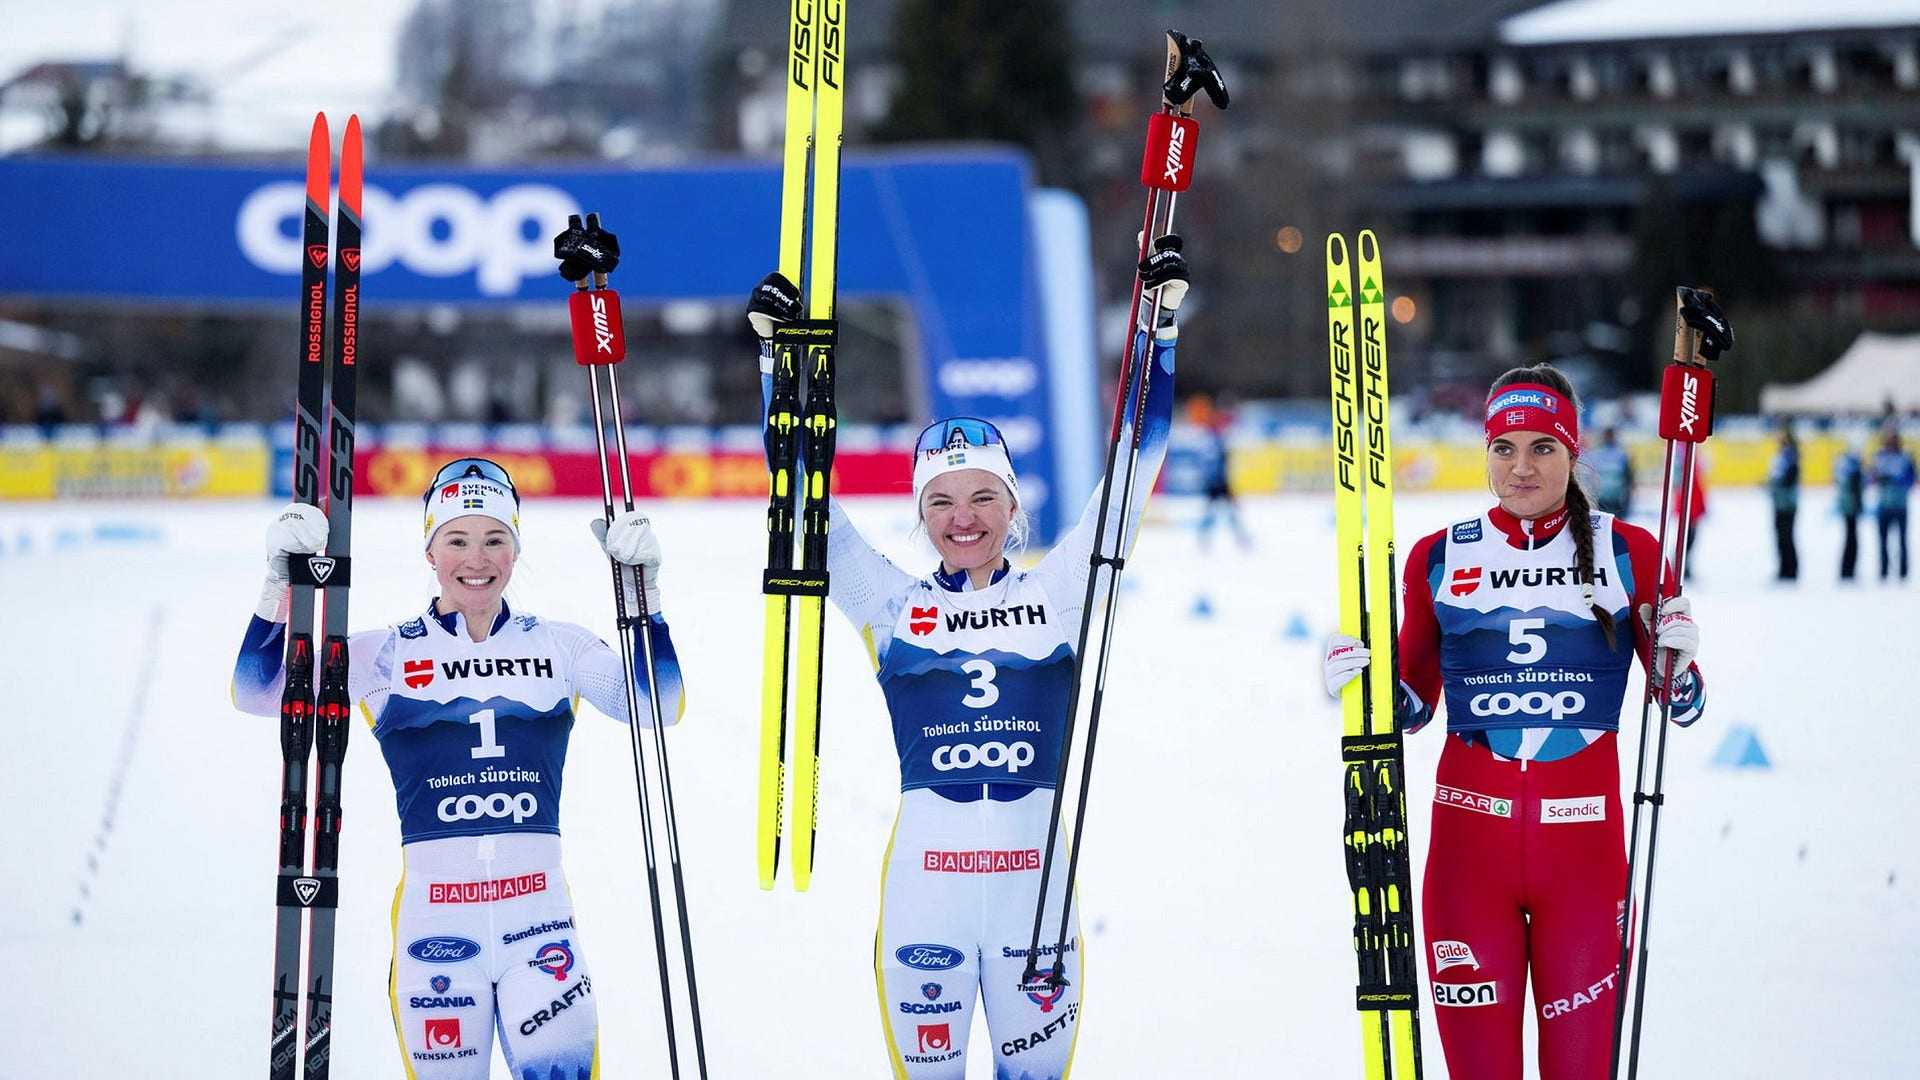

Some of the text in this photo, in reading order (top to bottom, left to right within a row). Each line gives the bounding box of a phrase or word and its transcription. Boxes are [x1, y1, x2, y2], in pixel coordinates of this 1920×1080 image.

[793, 0, 811, 90] FISC
[823, 0, 840, 90] FISC
[308, 281, 324, 362] ROSSIGNOL
[343, 284, 357, 365] ROSSIGNOL
[776, 328, 833, 336] FISCHER
[1333, 320, 1355, 492] FISCHER
[1364, 317, 1386, 488] FISCHER
[946, 444, 968, 452] SPEL
[462, 484, 504, 497] SVENSKA
[768, 579, 825, 587] FISCHER
[1505, 618, 1548, 664] 5
[959, 658, 1000, 709] 3
[1470, 690, 1586, 720] coop
[469, 708, 506, 760] 1
[922, 722, 970, 738] Toblach
[931, 741, 1035, 773] coop
[1344, 743, 1397, 752] FISCHER
[426, 772, 475, 790] Toblach
[437, 792, 538, 824] coop
[1439, 789, 1490, 810] SPAR
[1548, 803, 1600, 818] Scandic
[926, 850, 1040, 871] BAUHAUS
[431, 874, 545, 902] BAUHAUS
[502, 920, 570, 945] Sundström
[421, 940, 466, 958] Ford
[908, 947, 952, 966] Ford
[1436, 944, 1469, 959] Gilde
[528, 954, 565, 967] Thermia
[410, 996, 476, 1009] SCANIA
[1358, 994, 1412, 1002] FISCHER
[1542, 972, 1616, 1019] CRAFT
[520, 981, 584, 1036] CRAFT
[900, 1001, 962, 1015] SCANIA
[1001, 1012, 1067, 1057] CRAFT
[413, 1048, 478, 1061] SVENSKA SPEL
[904, 1054, 946, 1064] SVENSKA
